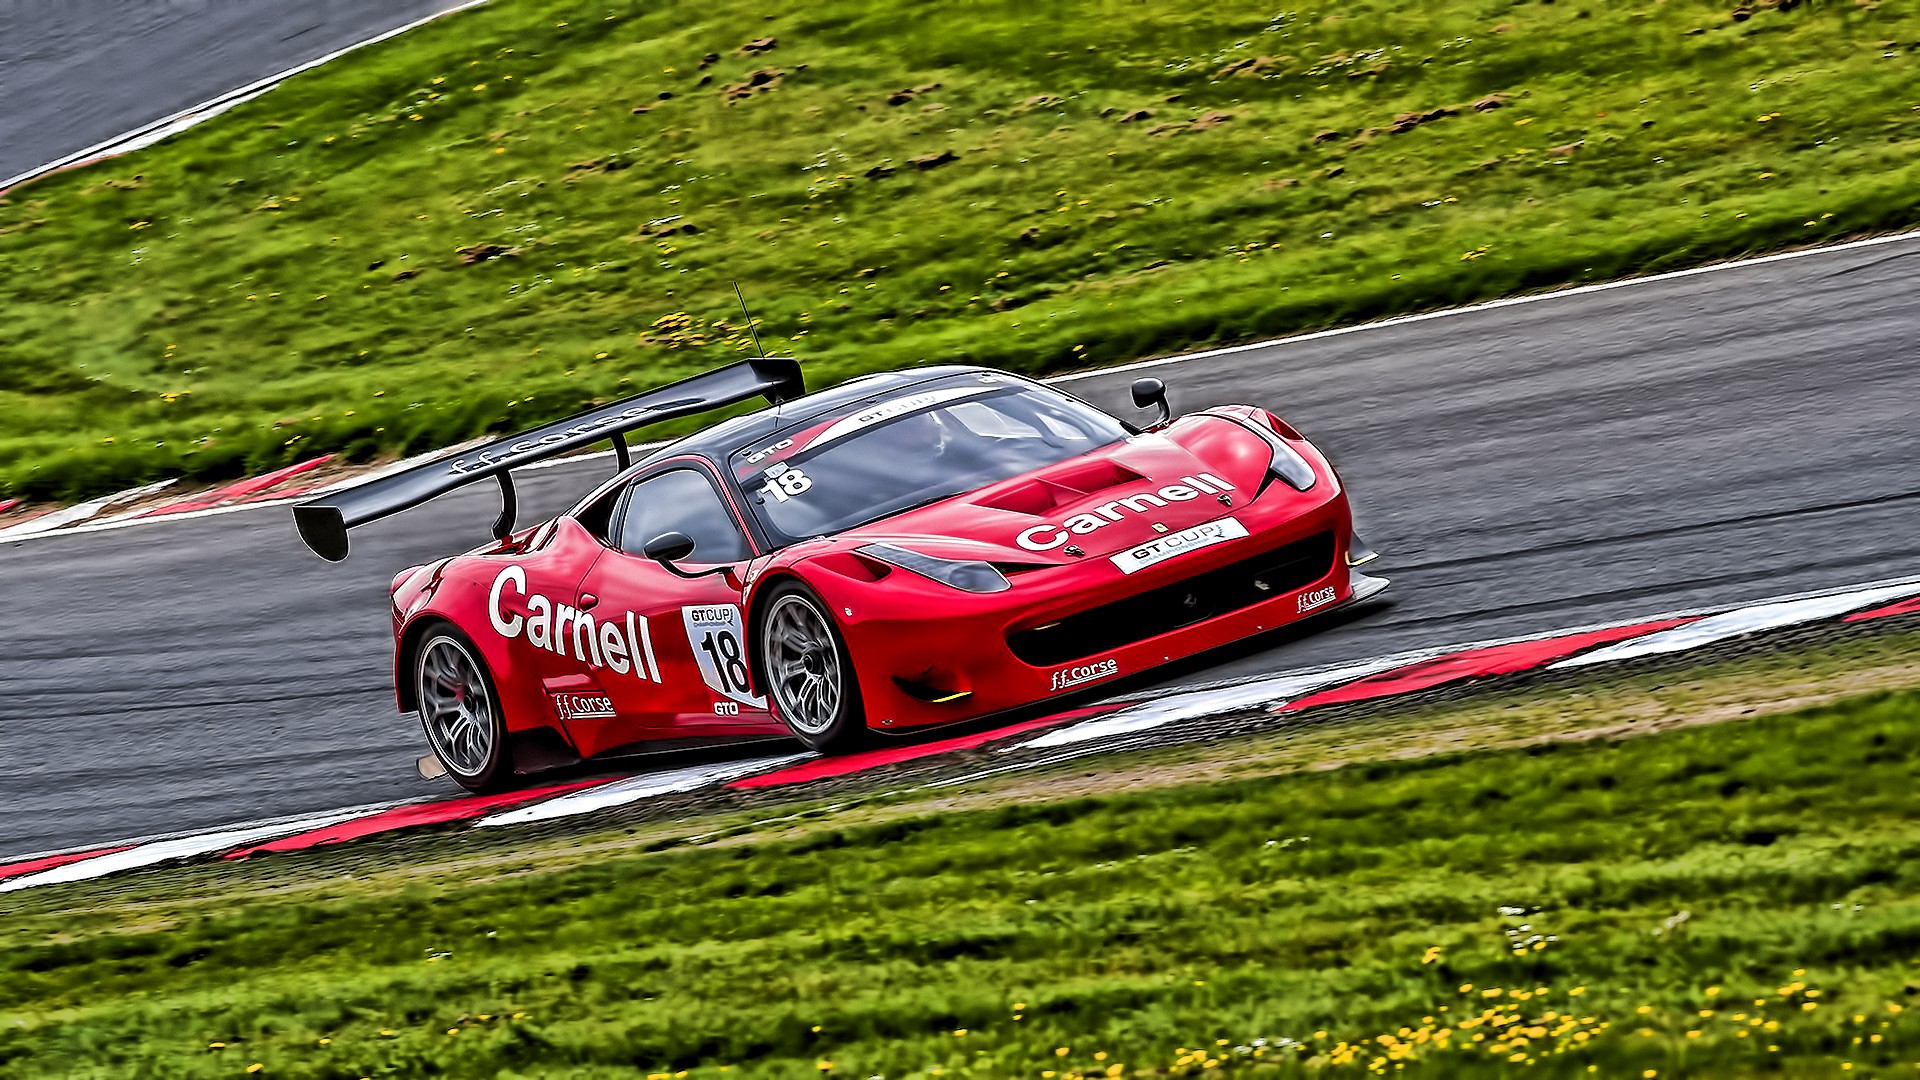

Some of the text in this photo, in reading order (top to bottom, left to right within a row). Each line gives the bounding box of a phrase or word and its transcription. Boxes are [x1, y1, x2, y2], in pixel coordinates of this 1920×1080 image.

[747, 438, 794, 464] GTO
[759, 468, 812, 503] 18
[1015, 472, 1236, 551] Carnell
[488, 564, 662, 684] Carnell
[700, 630, 752, 693] 18
[714, 702, 739, 715] GTO
